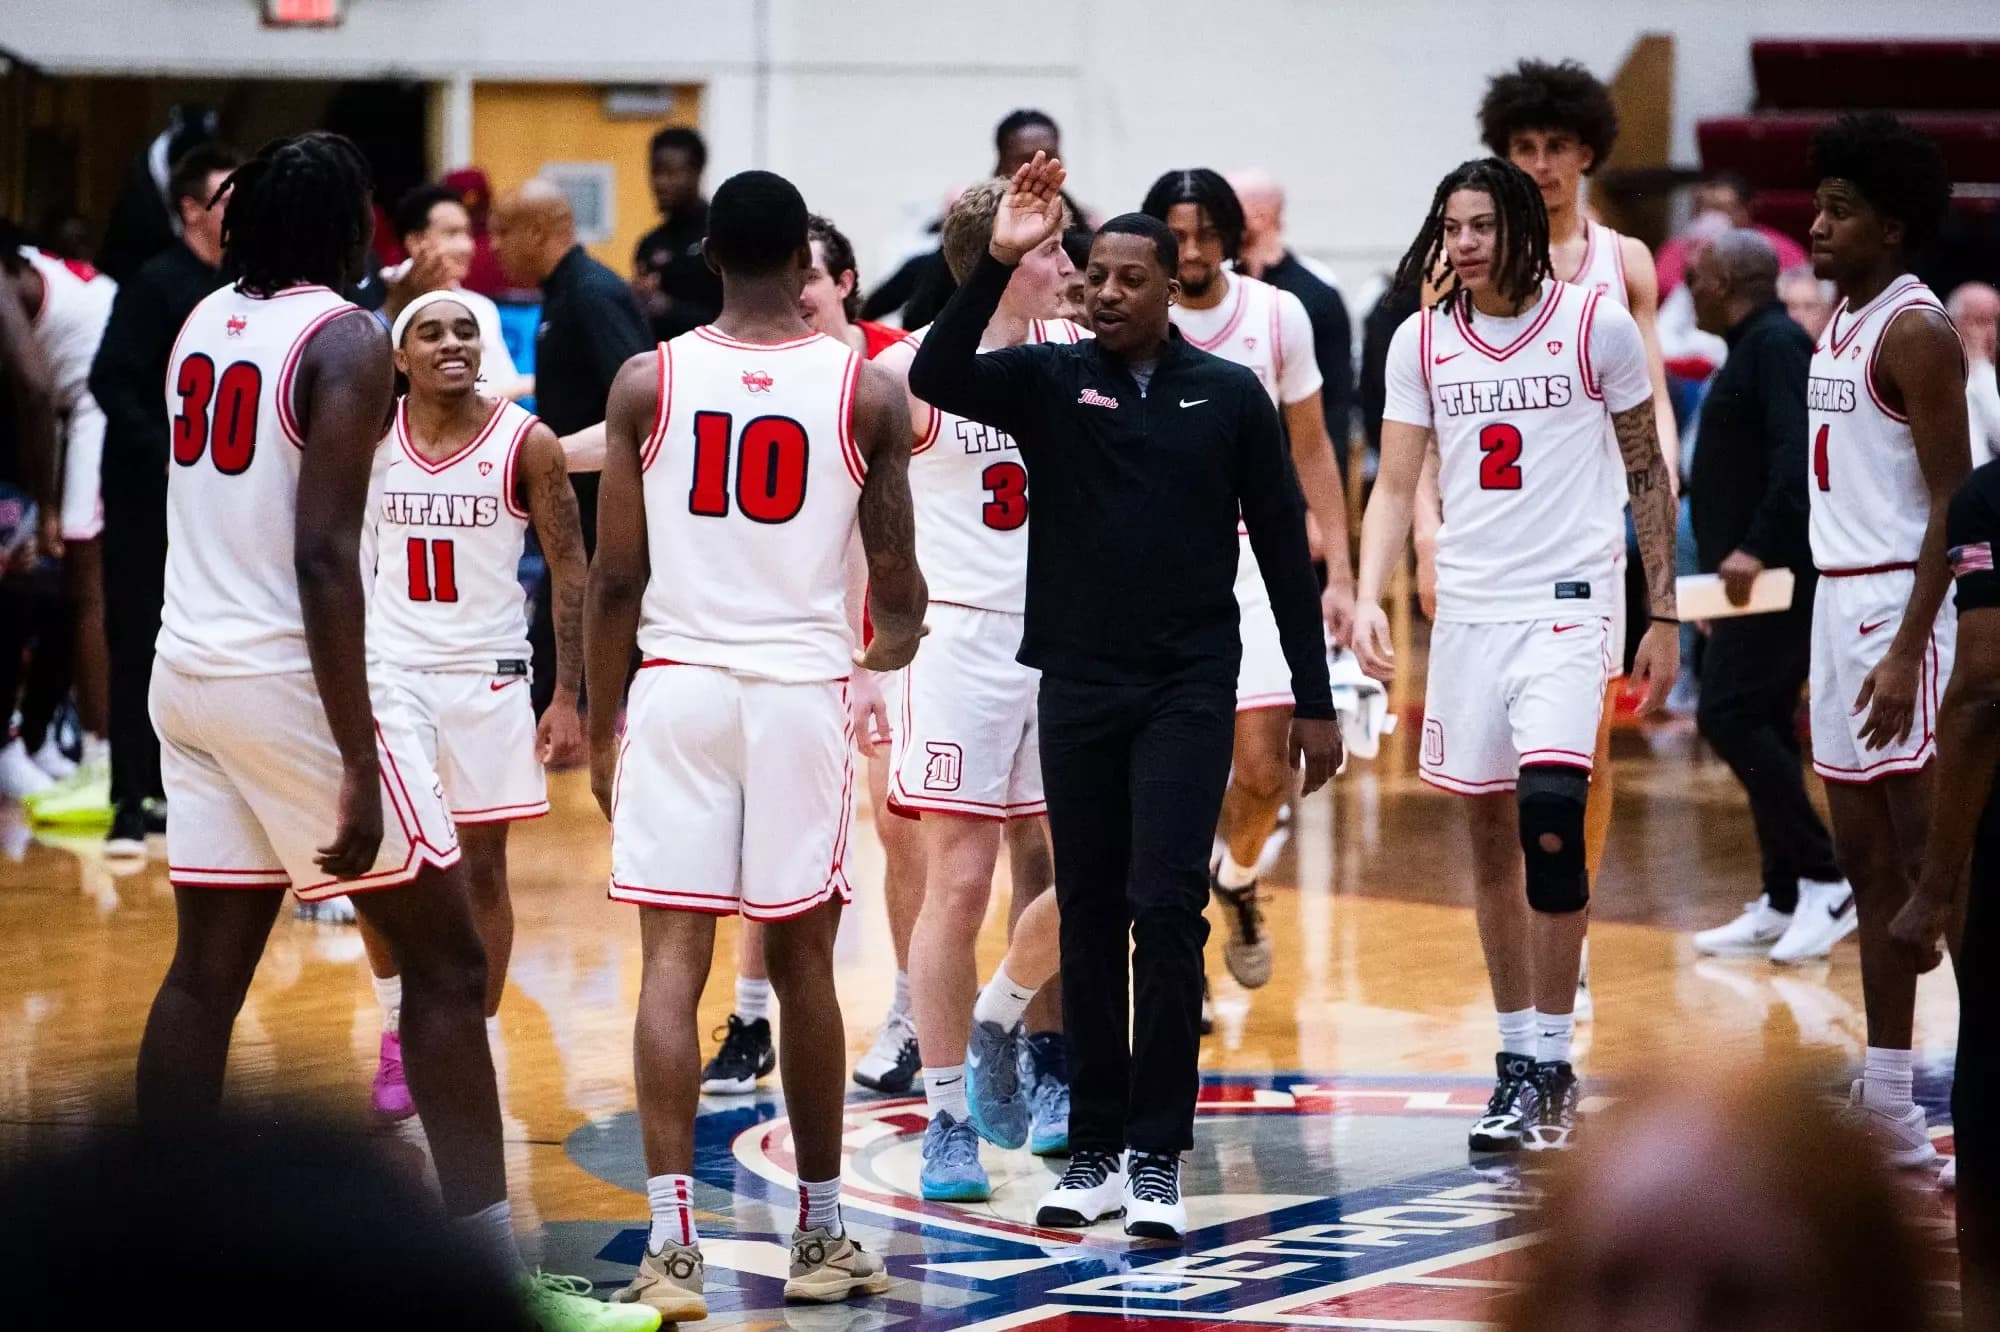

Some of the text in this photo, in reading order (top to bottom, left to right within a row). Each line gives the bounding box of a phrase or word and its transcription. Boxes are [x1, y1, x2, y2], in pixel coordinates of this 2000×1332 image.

[174, 352, 262, 476] 30
[1078, 388, 1119, 409] Titans
[1438, 375, 1572, 416] TITANS
[688, 410, 810, 525] 10
[1479, 423, 1523, 490] 2
[982, 461, 1029, 531] 3
[407, 536, 459, 603] 11
[1044, 1183, 1550, 1300] DETROIT
